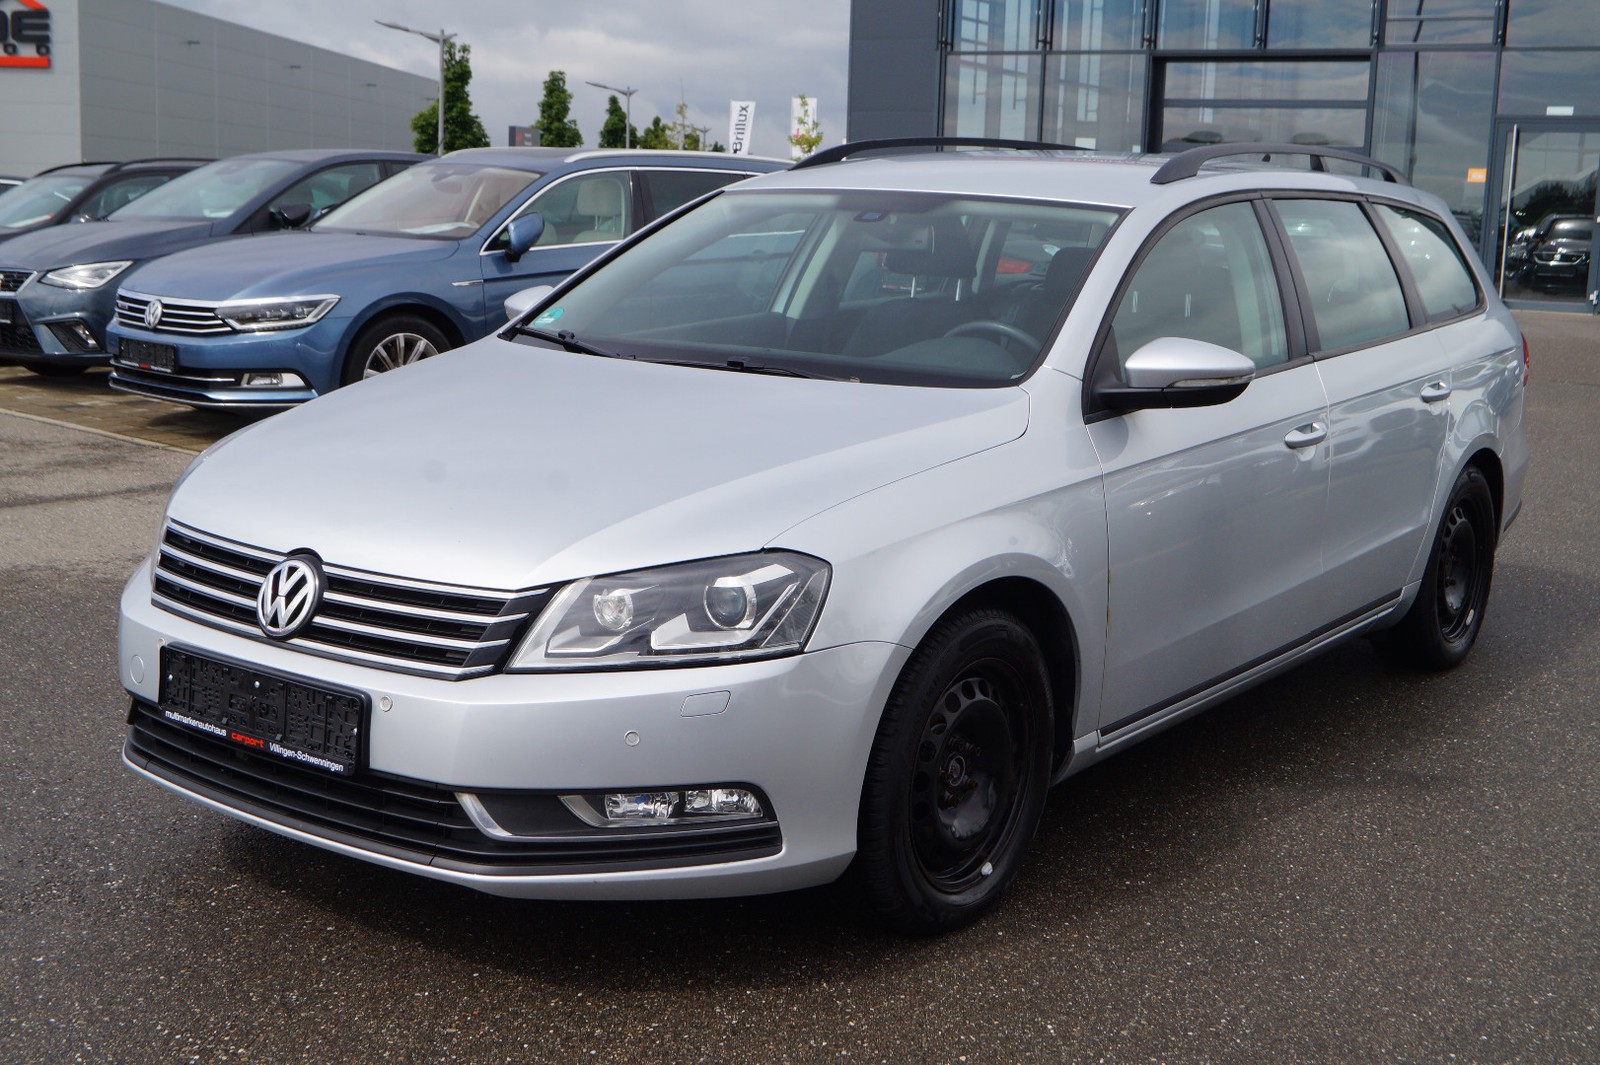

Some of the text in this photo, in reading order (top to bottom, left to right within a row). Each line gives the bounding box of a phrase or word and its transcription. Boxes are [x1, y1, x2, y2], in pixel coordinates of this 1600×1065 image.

[732, 104, 749, 153] Brillux
[165, 709, 343, 771] multimarkenautohaus carport Villingen-Schwenningen
